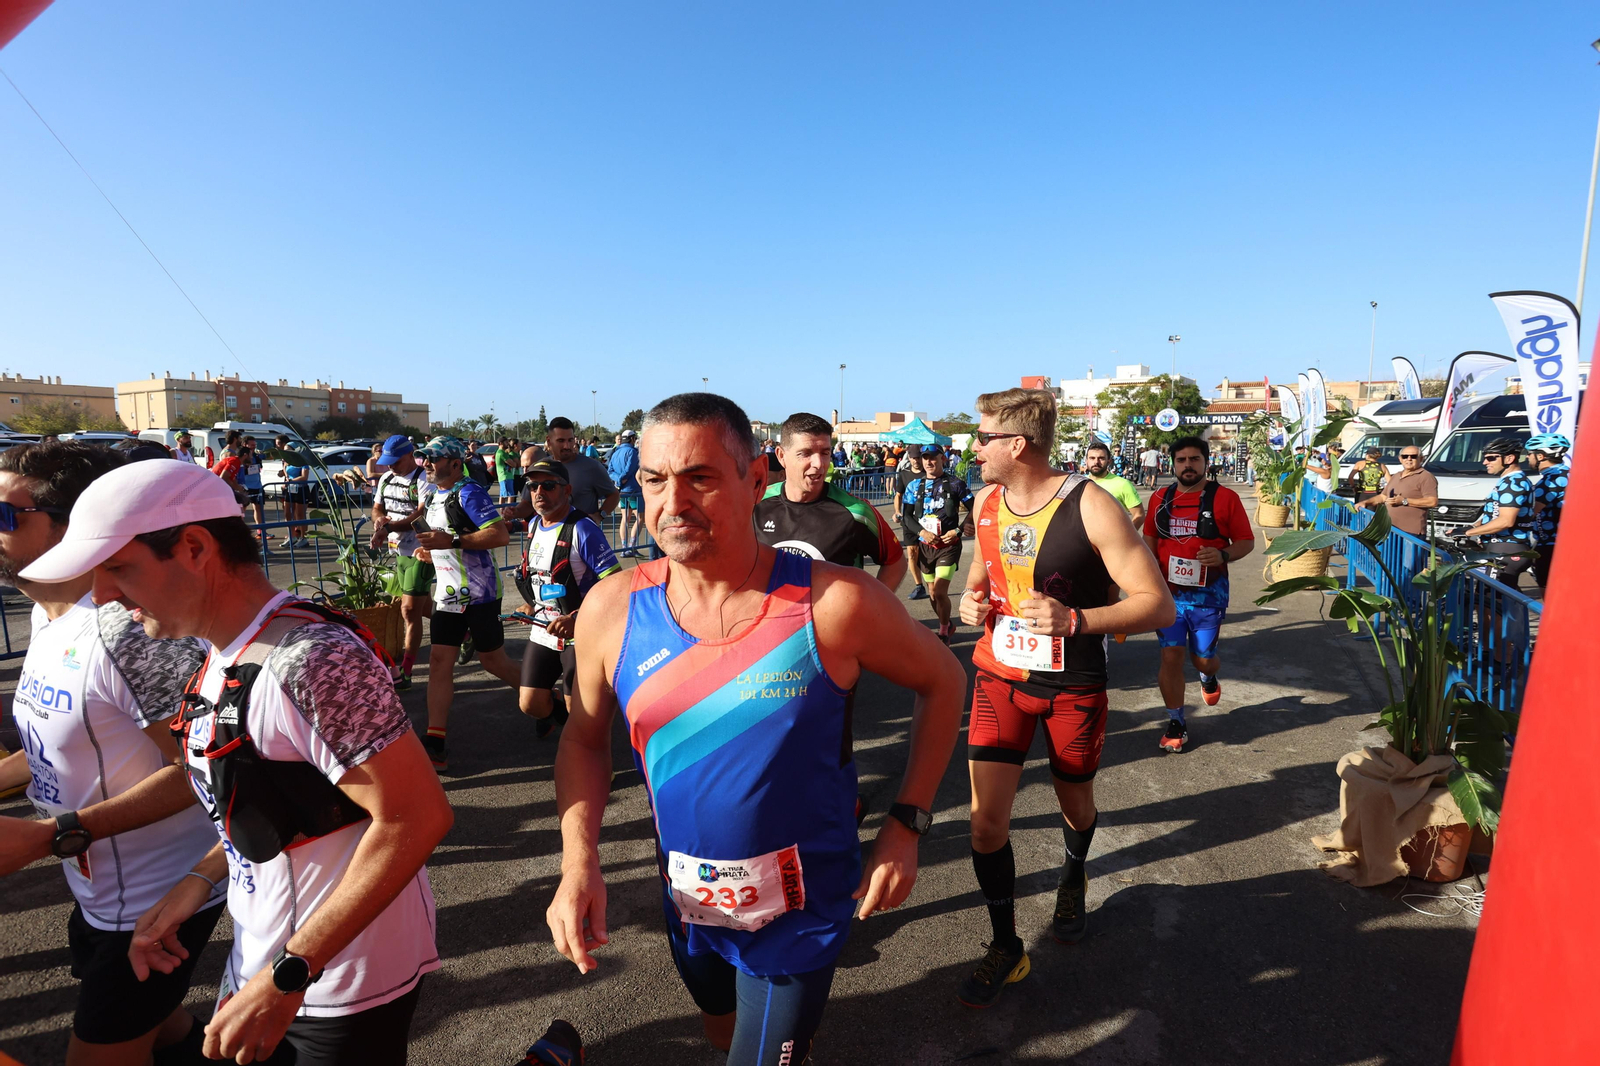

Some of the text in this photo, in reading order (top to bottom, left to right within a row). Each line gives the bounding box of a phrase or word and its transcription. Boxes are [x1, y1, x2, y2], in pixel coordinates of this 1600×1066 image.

[1185, 415, 1243, 424] TRAIL PIRATA
[1175, 566, 1193, 576] 204
[1005, 633, 1039, 652] 319
[1053, 637, 1061, 664] PIRAT
[636, 647, 671, 677] Joma
[736, 669, 803, 684] LA LEGIÓN
[739, 686, 807, 700] 101 KM 24 H
[718, 870, 750, 878] PIRATA
[782, 858, 802, 911] PIRATA
[695, 885, 760, 910] 233
